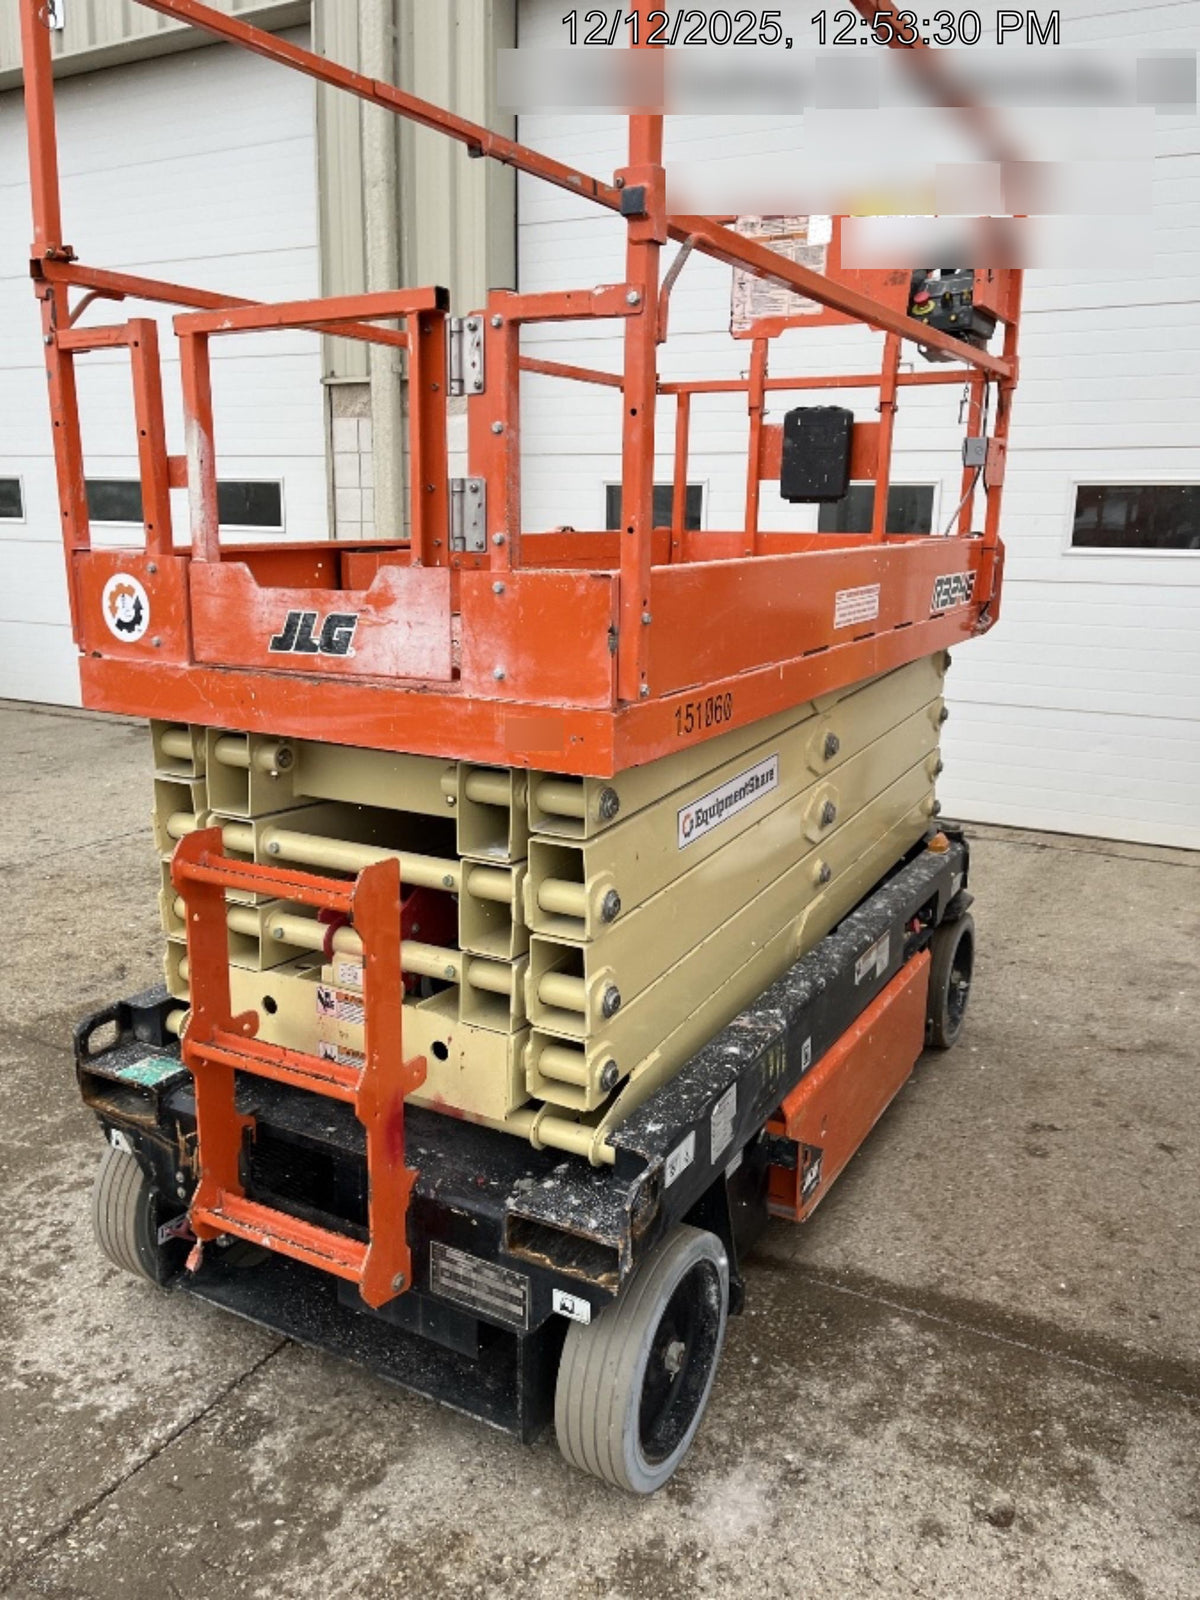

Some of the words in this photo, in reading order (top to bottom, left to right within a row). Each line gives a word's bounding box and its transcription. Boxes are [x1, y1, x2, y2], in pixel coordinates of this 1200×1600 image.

[268, 609, 359, 657] JLG
[675, 692, 732, 736] 151060
[694, 767, 775, 829] EquipmentShare
